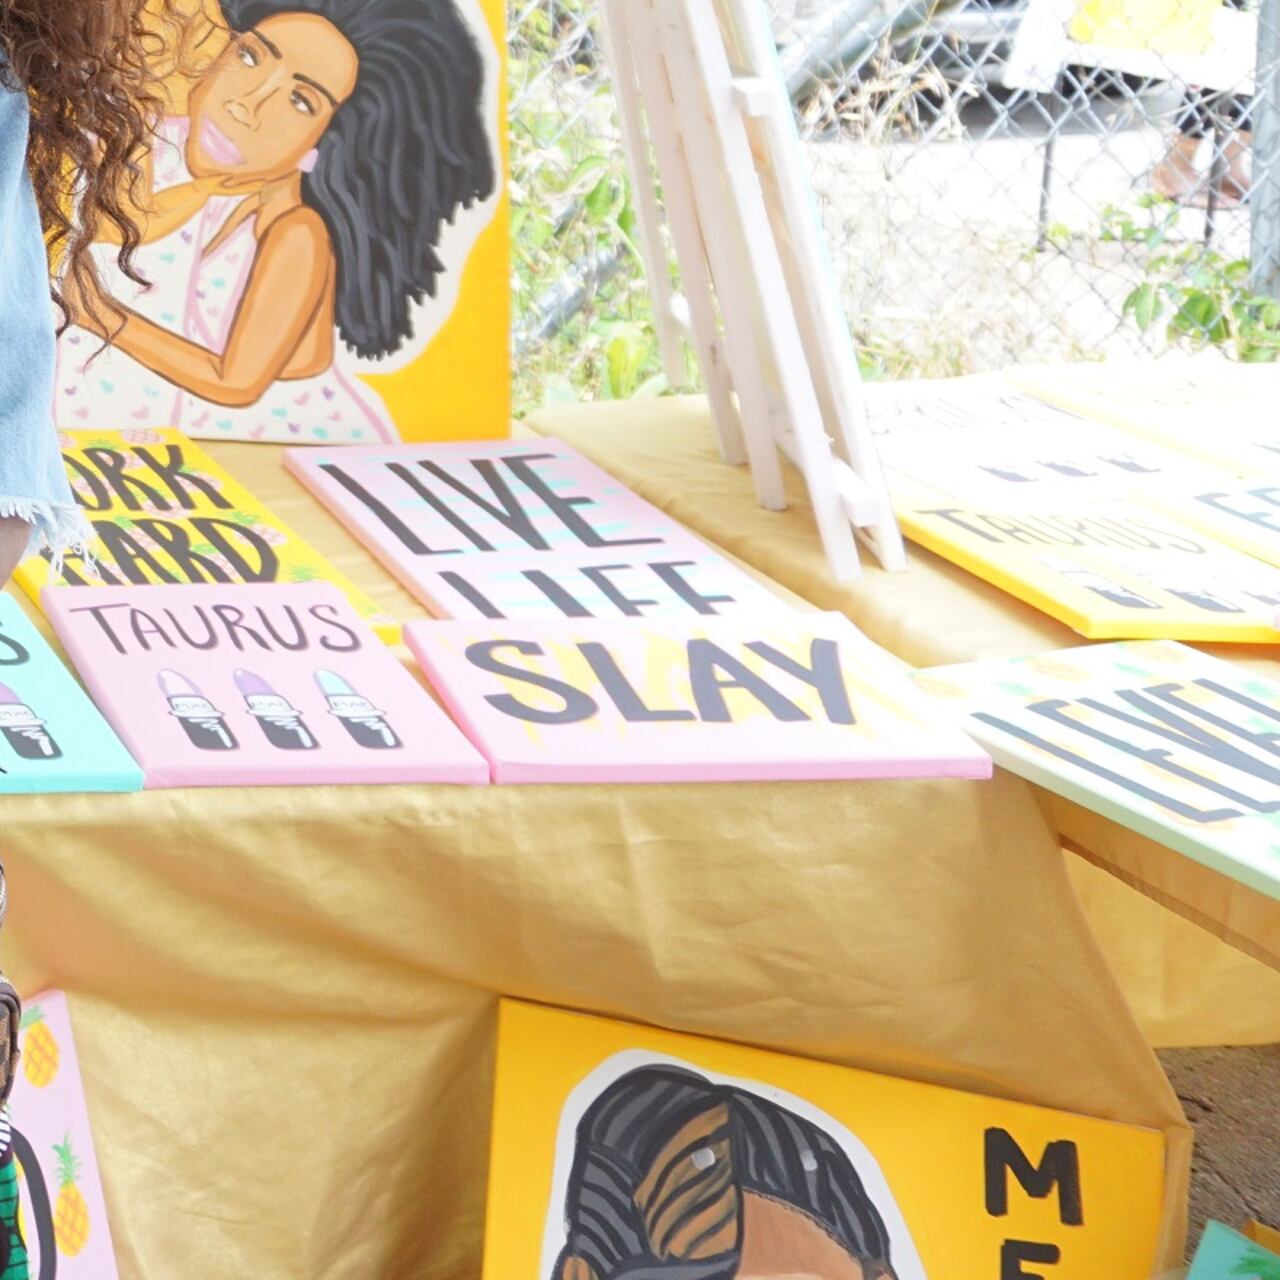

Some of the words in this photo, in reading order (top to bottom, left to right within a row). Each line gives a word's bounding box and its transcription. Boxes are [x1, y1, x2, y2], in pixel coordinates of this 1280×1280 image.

[61, 444, 236, 511] ORK
[317, 452, 665, 556] LIVE
[69, 602, 364, 656] TAURUS
[465, 635, 857, 726] SLAY
